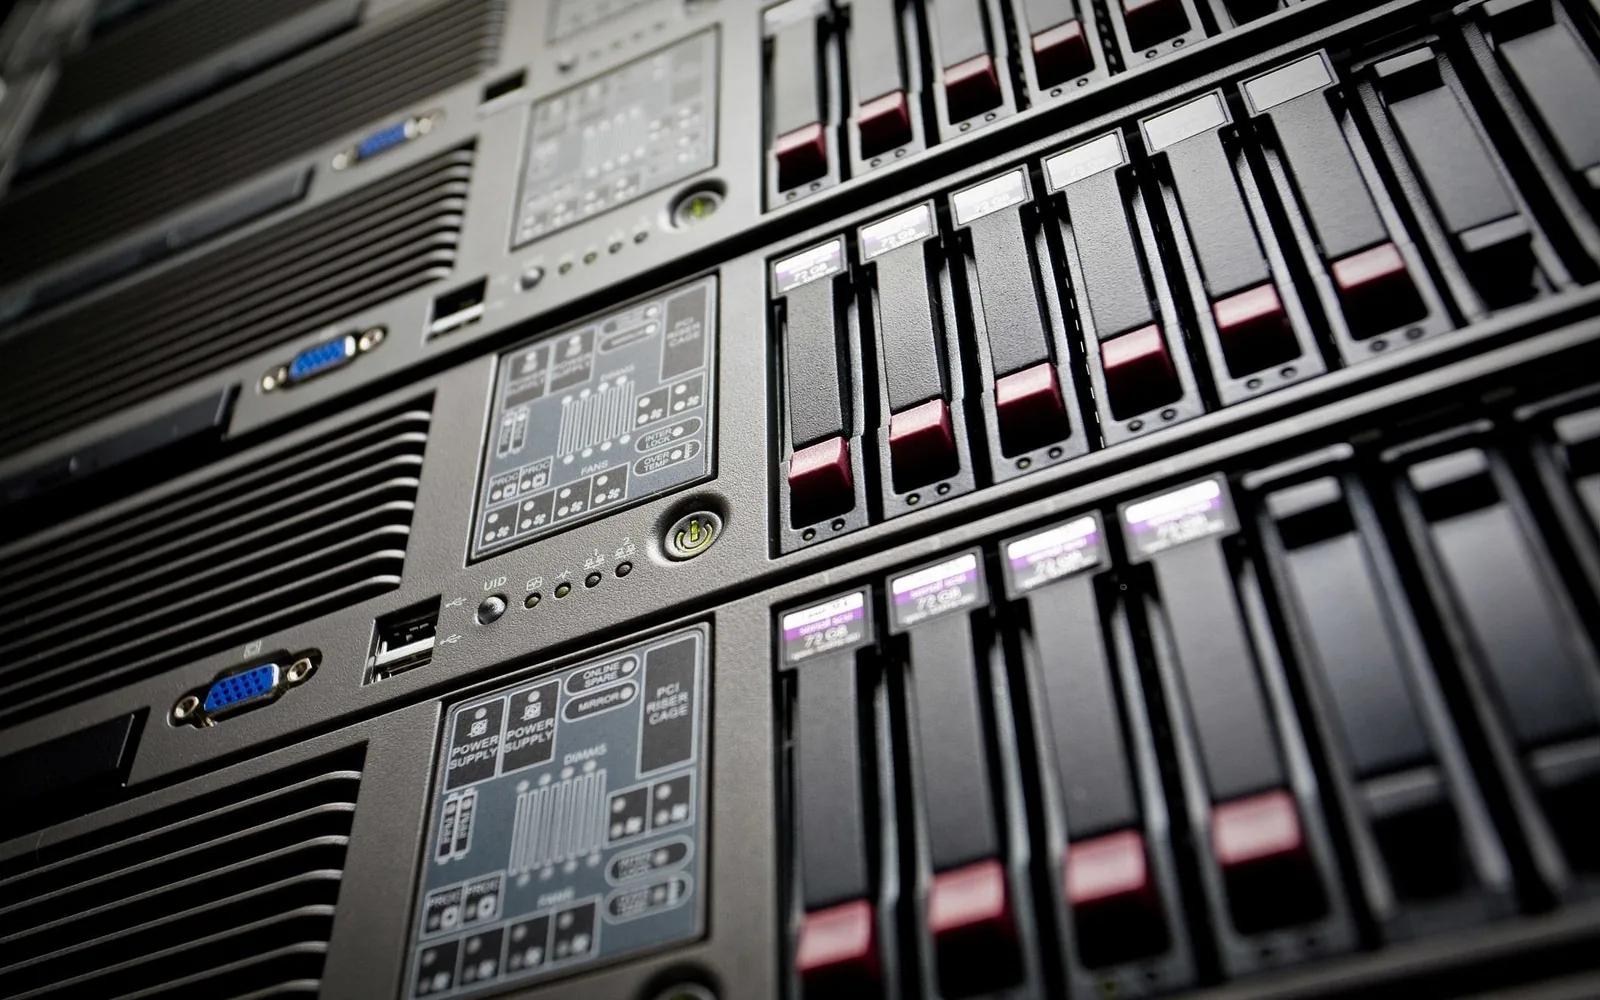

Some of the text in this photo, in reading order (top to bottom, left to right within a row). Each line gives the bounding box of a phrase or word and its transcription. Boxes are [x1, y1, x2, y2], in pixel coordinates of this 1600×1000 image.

[645, 428, 672, 443] INTER
[646, 437, 670, 449] LOCK
[580, 459, 608, 476] FANS
[644, 451, 670, 465] OVER
[644, 458, 669, 471] TEMP
[520, 460, 550, 477] PROC
[483, 576, 507, 591] UID
[804, 632, 824, 649] 72
[824, 623, 849, 641] GB
[583, 661, 620, 680] ONLINE
[584, 670, 618, 688] SPARE
[656, 681, 680, 700] PCI
[578, 691, 620, 712] MIRROR
[646, 691, 689, 715] RISER
[648, 703, 689, 726] CAGE
[506, 717, 555, 741] POWER
[452, 735, 499, 758] POWER
[503, 730, 554, 754] SUPPLY
[448, 746, 498, 770] SUPPLY
[563, 742, 608, 766] DIMMS
